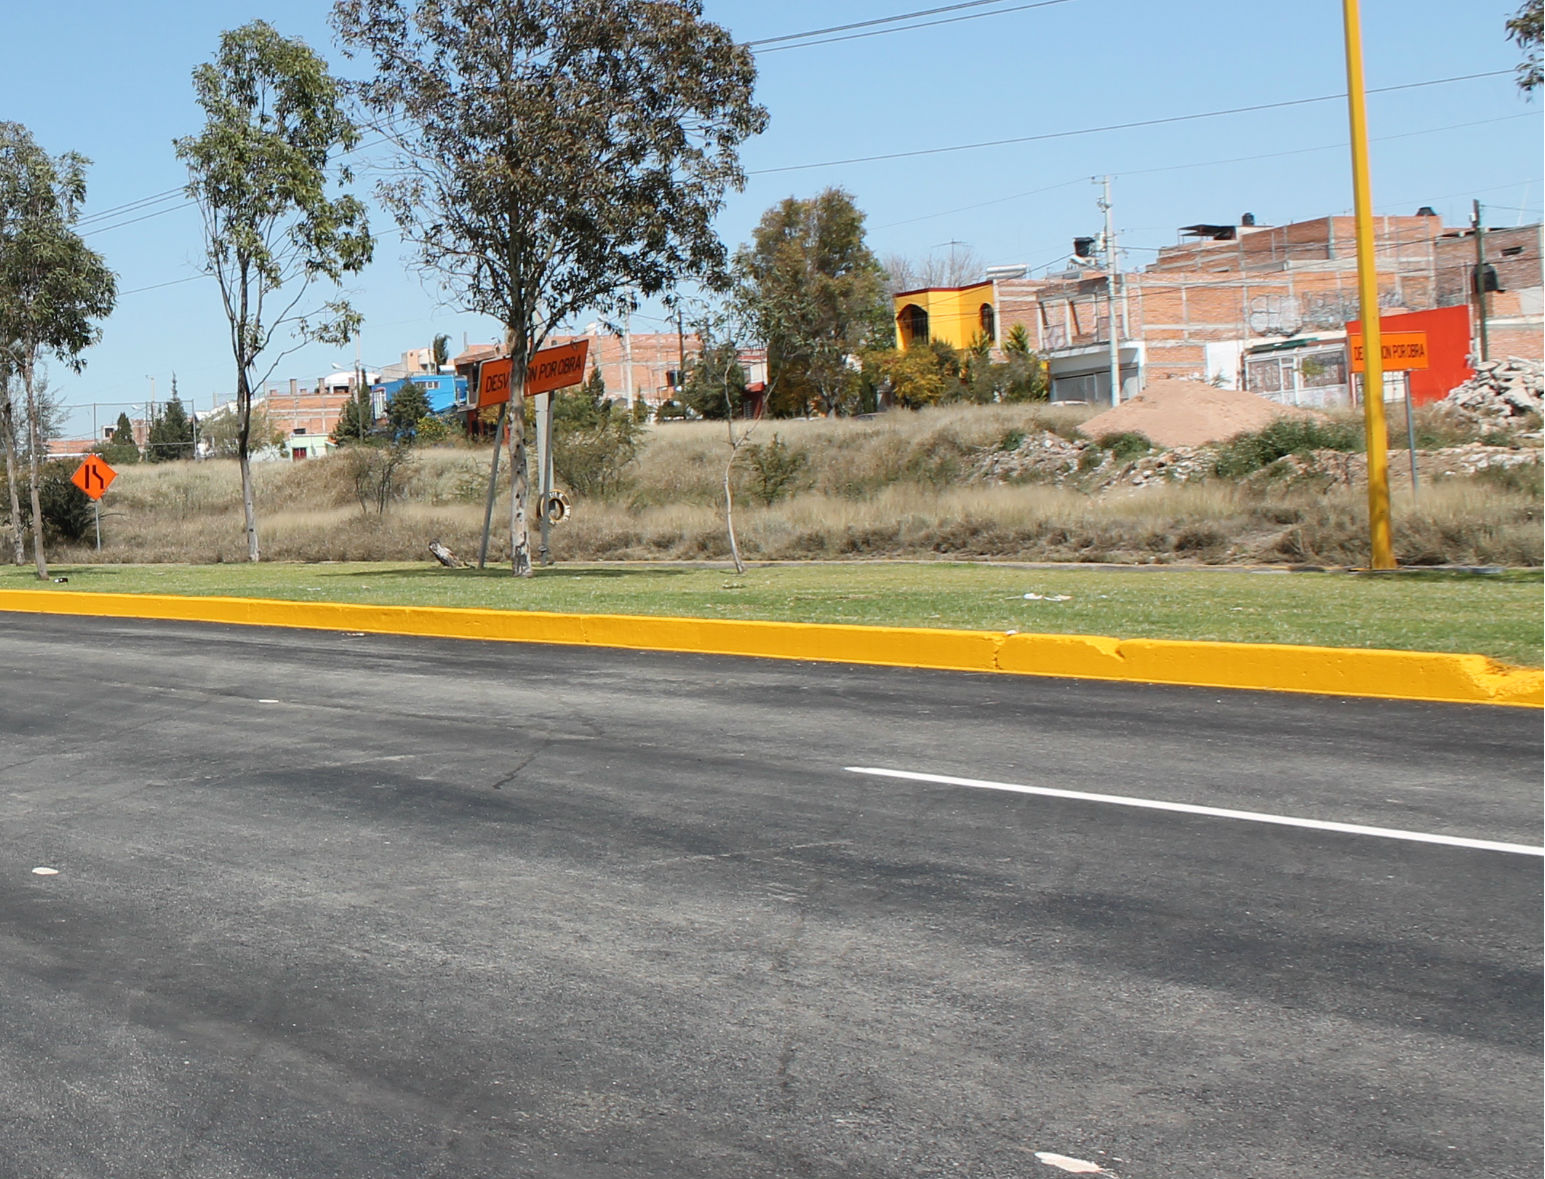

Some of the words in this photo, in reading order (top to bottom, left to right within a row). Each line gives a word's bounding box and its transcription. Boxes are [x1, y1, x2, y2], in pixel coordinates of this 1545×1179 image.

[1392, 344, 1406, 359] POR
[1406, 343, 1425, 358] OBRA
[485, 365, 538, 393] DESVON
[539, 361, 558, 380] POR
[558, 355, 582, 375] OBRA
